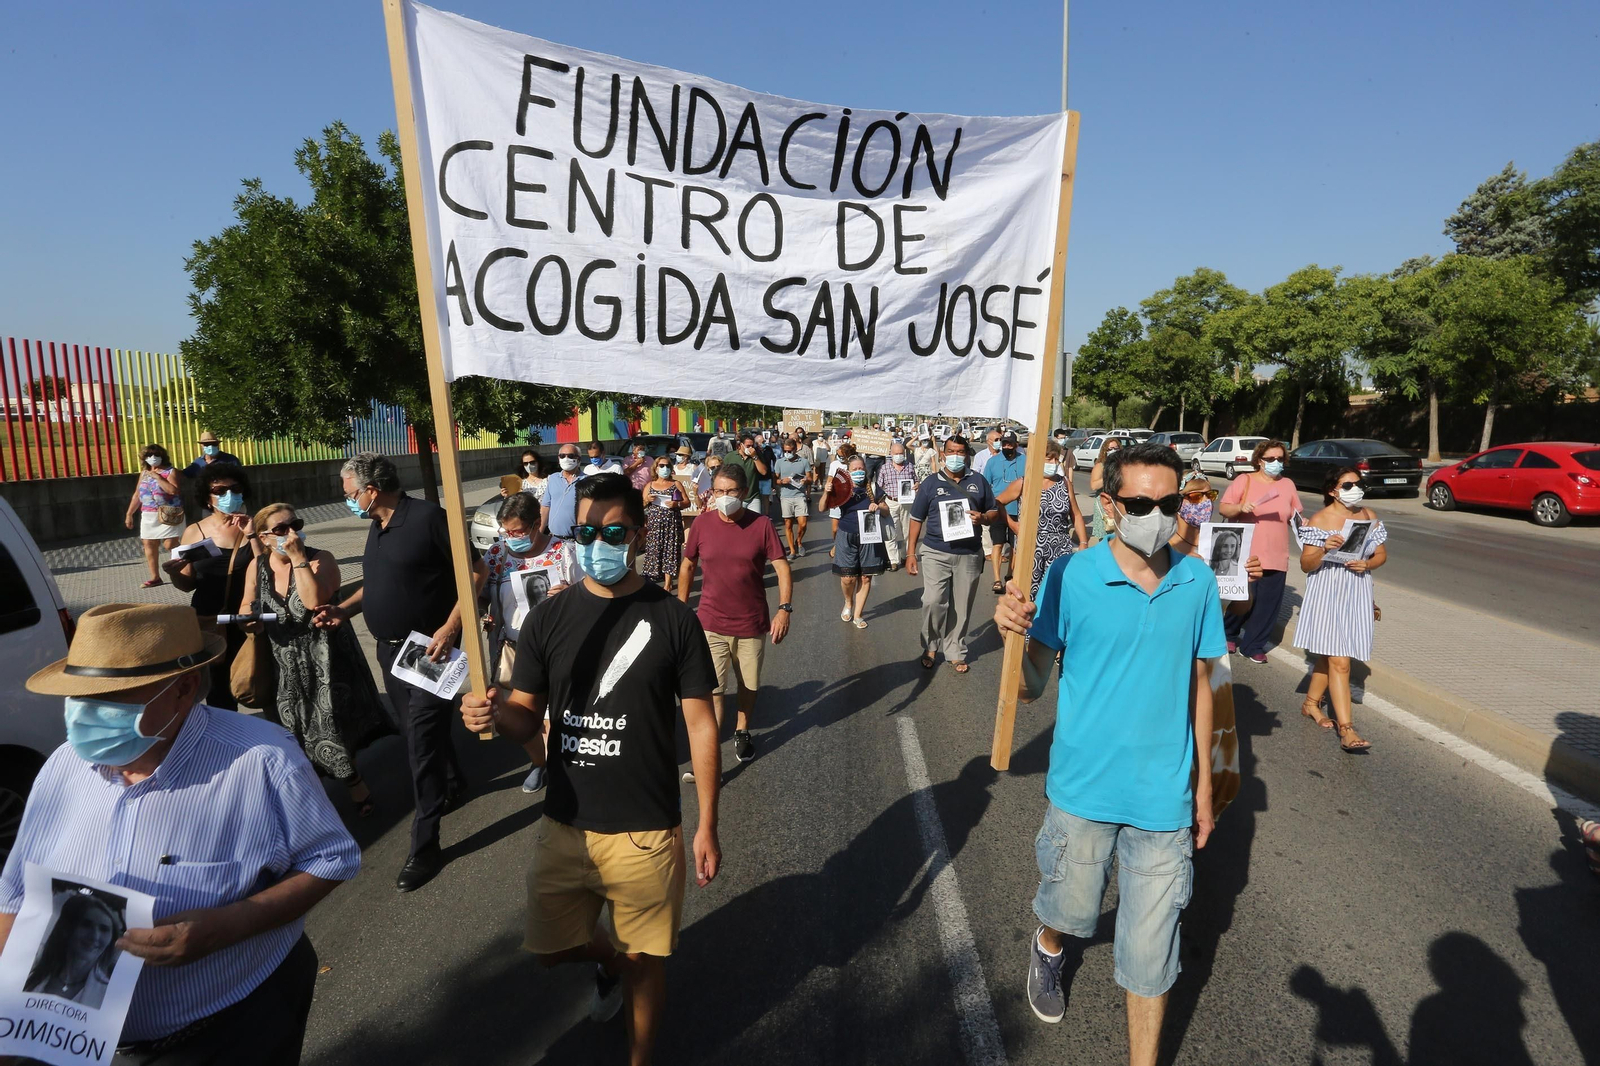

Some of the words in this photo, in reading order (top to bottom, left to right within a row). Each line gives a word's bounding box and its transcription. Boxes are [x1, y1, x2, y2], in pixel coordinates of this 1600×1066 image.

[516, 54, 962, 200] FUNDACIÓN
[439, 140, 784, 262] CENTRO
[836, 201, 928, 275] DE
[445, 239, 740, 351] ACOGIDA
[760, 276, 879, 360] SAN
[908, 267, 1051, 361] JOSÉ
[563, 709, 614, 730] Samba
[615, 714, 627, 730] é
[561, 733, 622, 757] poesia
[25, 997, 88, 1023] DIRECTORA
[0, 1017, 106, 1061] DIMISIÓN
